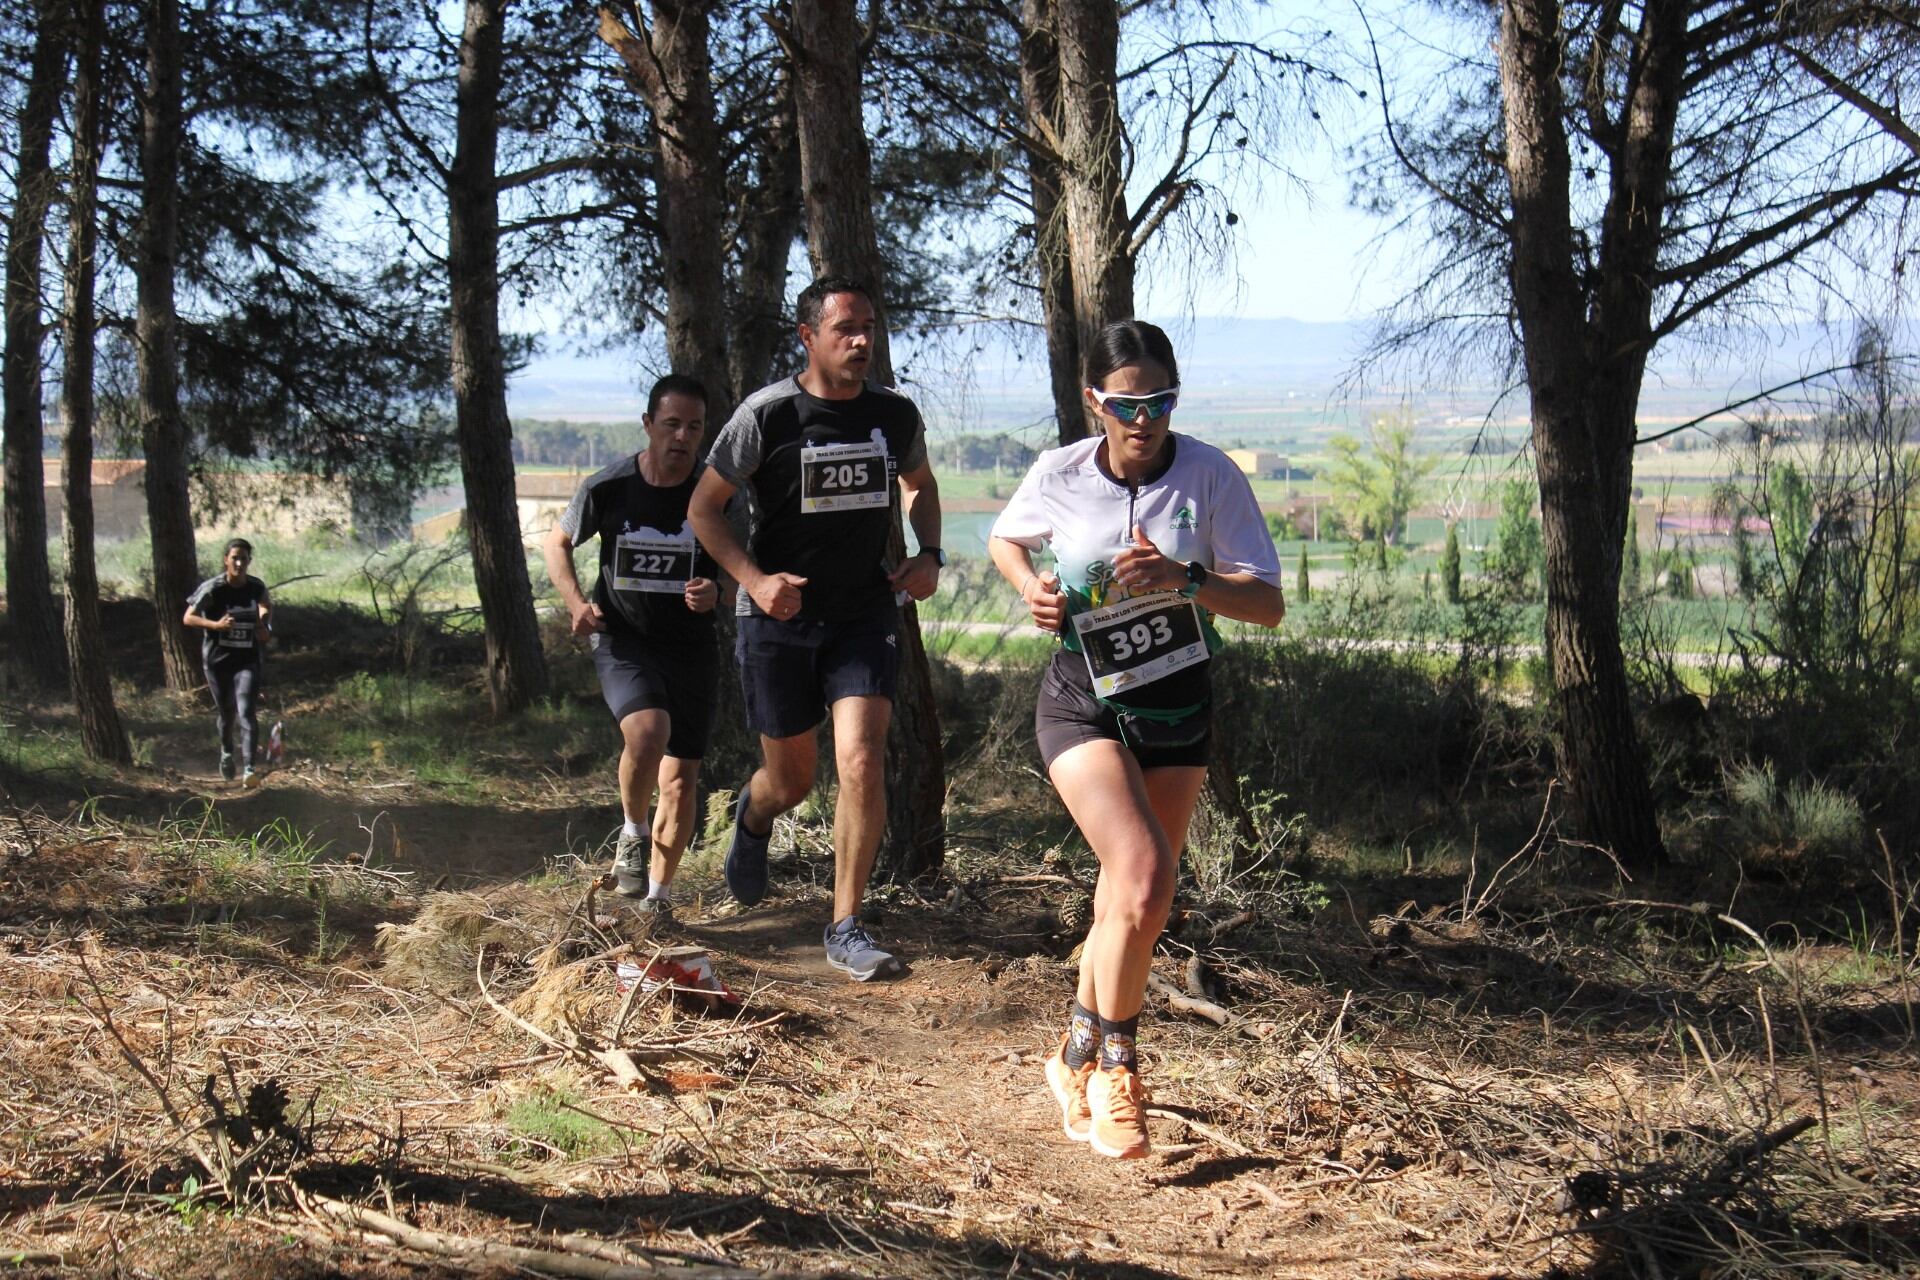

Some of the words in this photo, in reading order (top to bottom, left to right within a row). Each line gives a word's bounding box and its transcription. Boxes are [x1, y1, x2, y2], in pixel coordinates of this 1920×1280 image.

[822, 463, 869, 488] 205
[632, 554, 676, 574] 227
[1094, 614, 1111, 624] TRAIL
[1111, 611, 1120, 619] DE
[1119, 608, 1131, 617] LOS
[1107, 615, 1173, 661] 393
